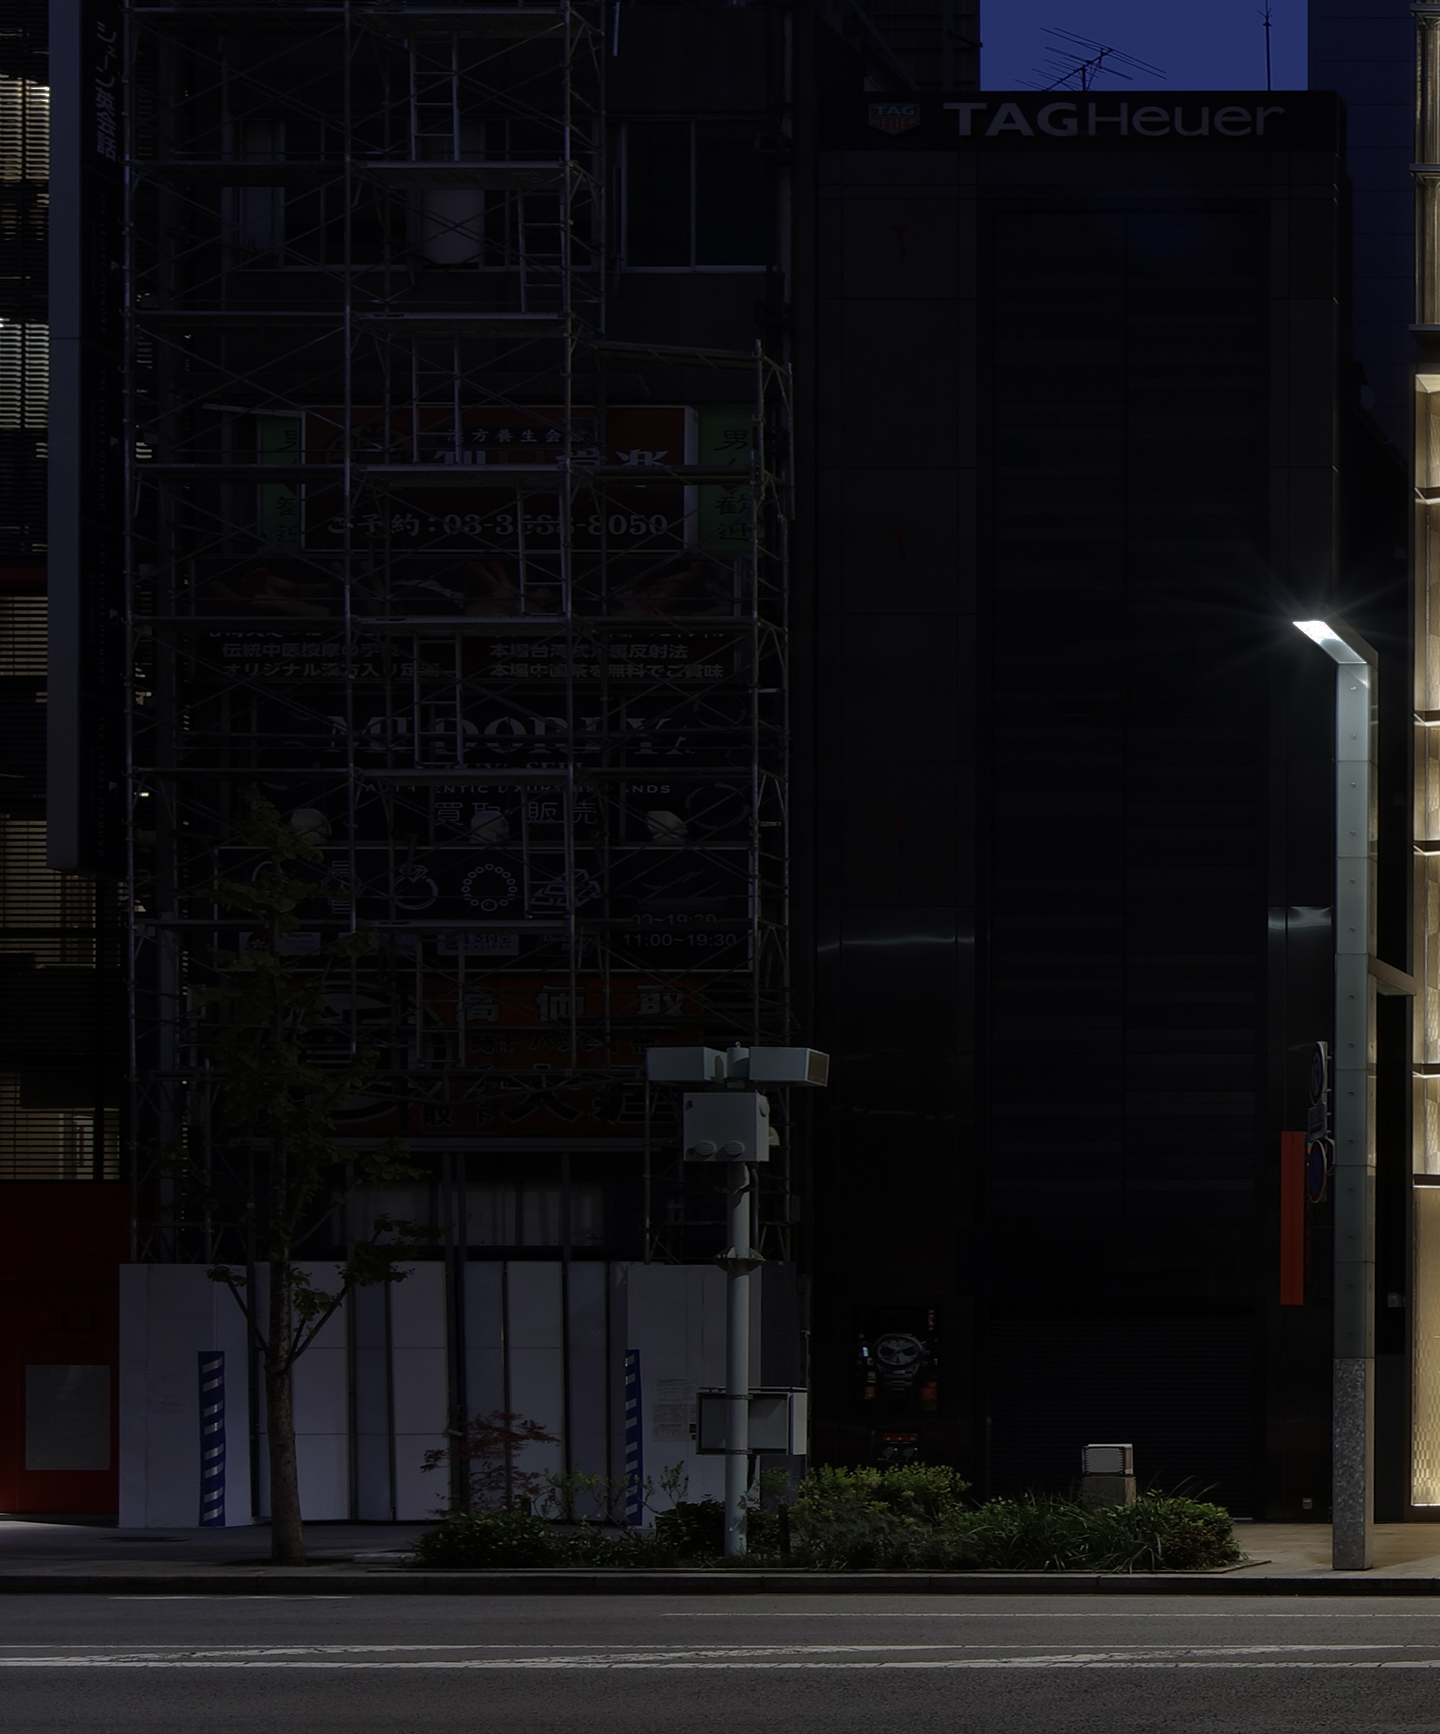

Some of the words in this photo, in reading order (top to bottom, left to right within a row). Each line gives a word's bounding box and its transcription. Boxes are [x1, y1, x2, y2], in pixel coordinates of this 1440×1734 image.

[95, 20, 117, 162] シェーン英会話
[874, 104, 915, 116] TAG
[714, 429, 750, 541] 男歓迎
[489, 643, 688, 659] 本場台湾式裏反射法
[622, 933, 737, 947] 11:00~19:30
